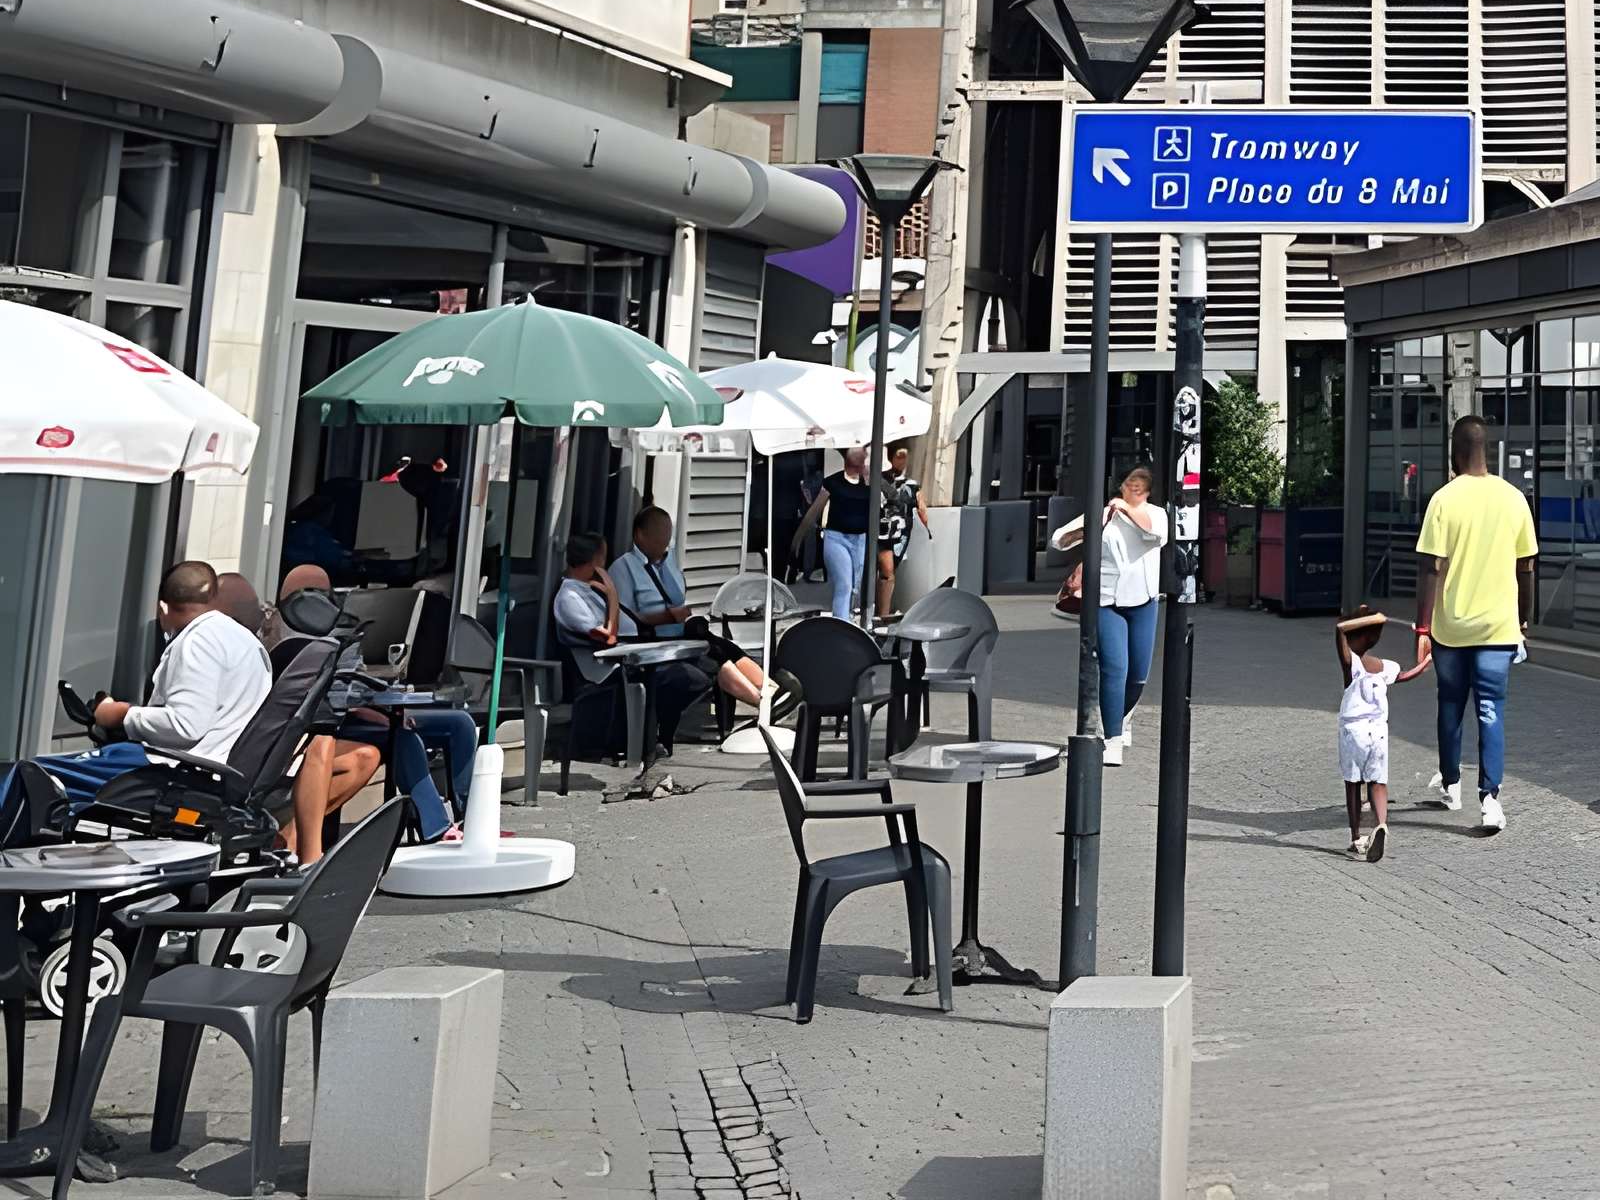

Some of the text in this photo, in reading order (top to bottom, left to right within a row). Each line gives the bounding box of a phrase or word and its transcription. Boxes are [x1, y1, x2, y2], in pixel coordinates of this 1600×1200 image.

[1210, 131, 1360, 166] Tramway
[1162, 180, 1179, 201] P
[1307, 177, 1344, 204] du
[1358, 177, 1378, 204] 8
[1391, 176, 1451, 205] Mai
